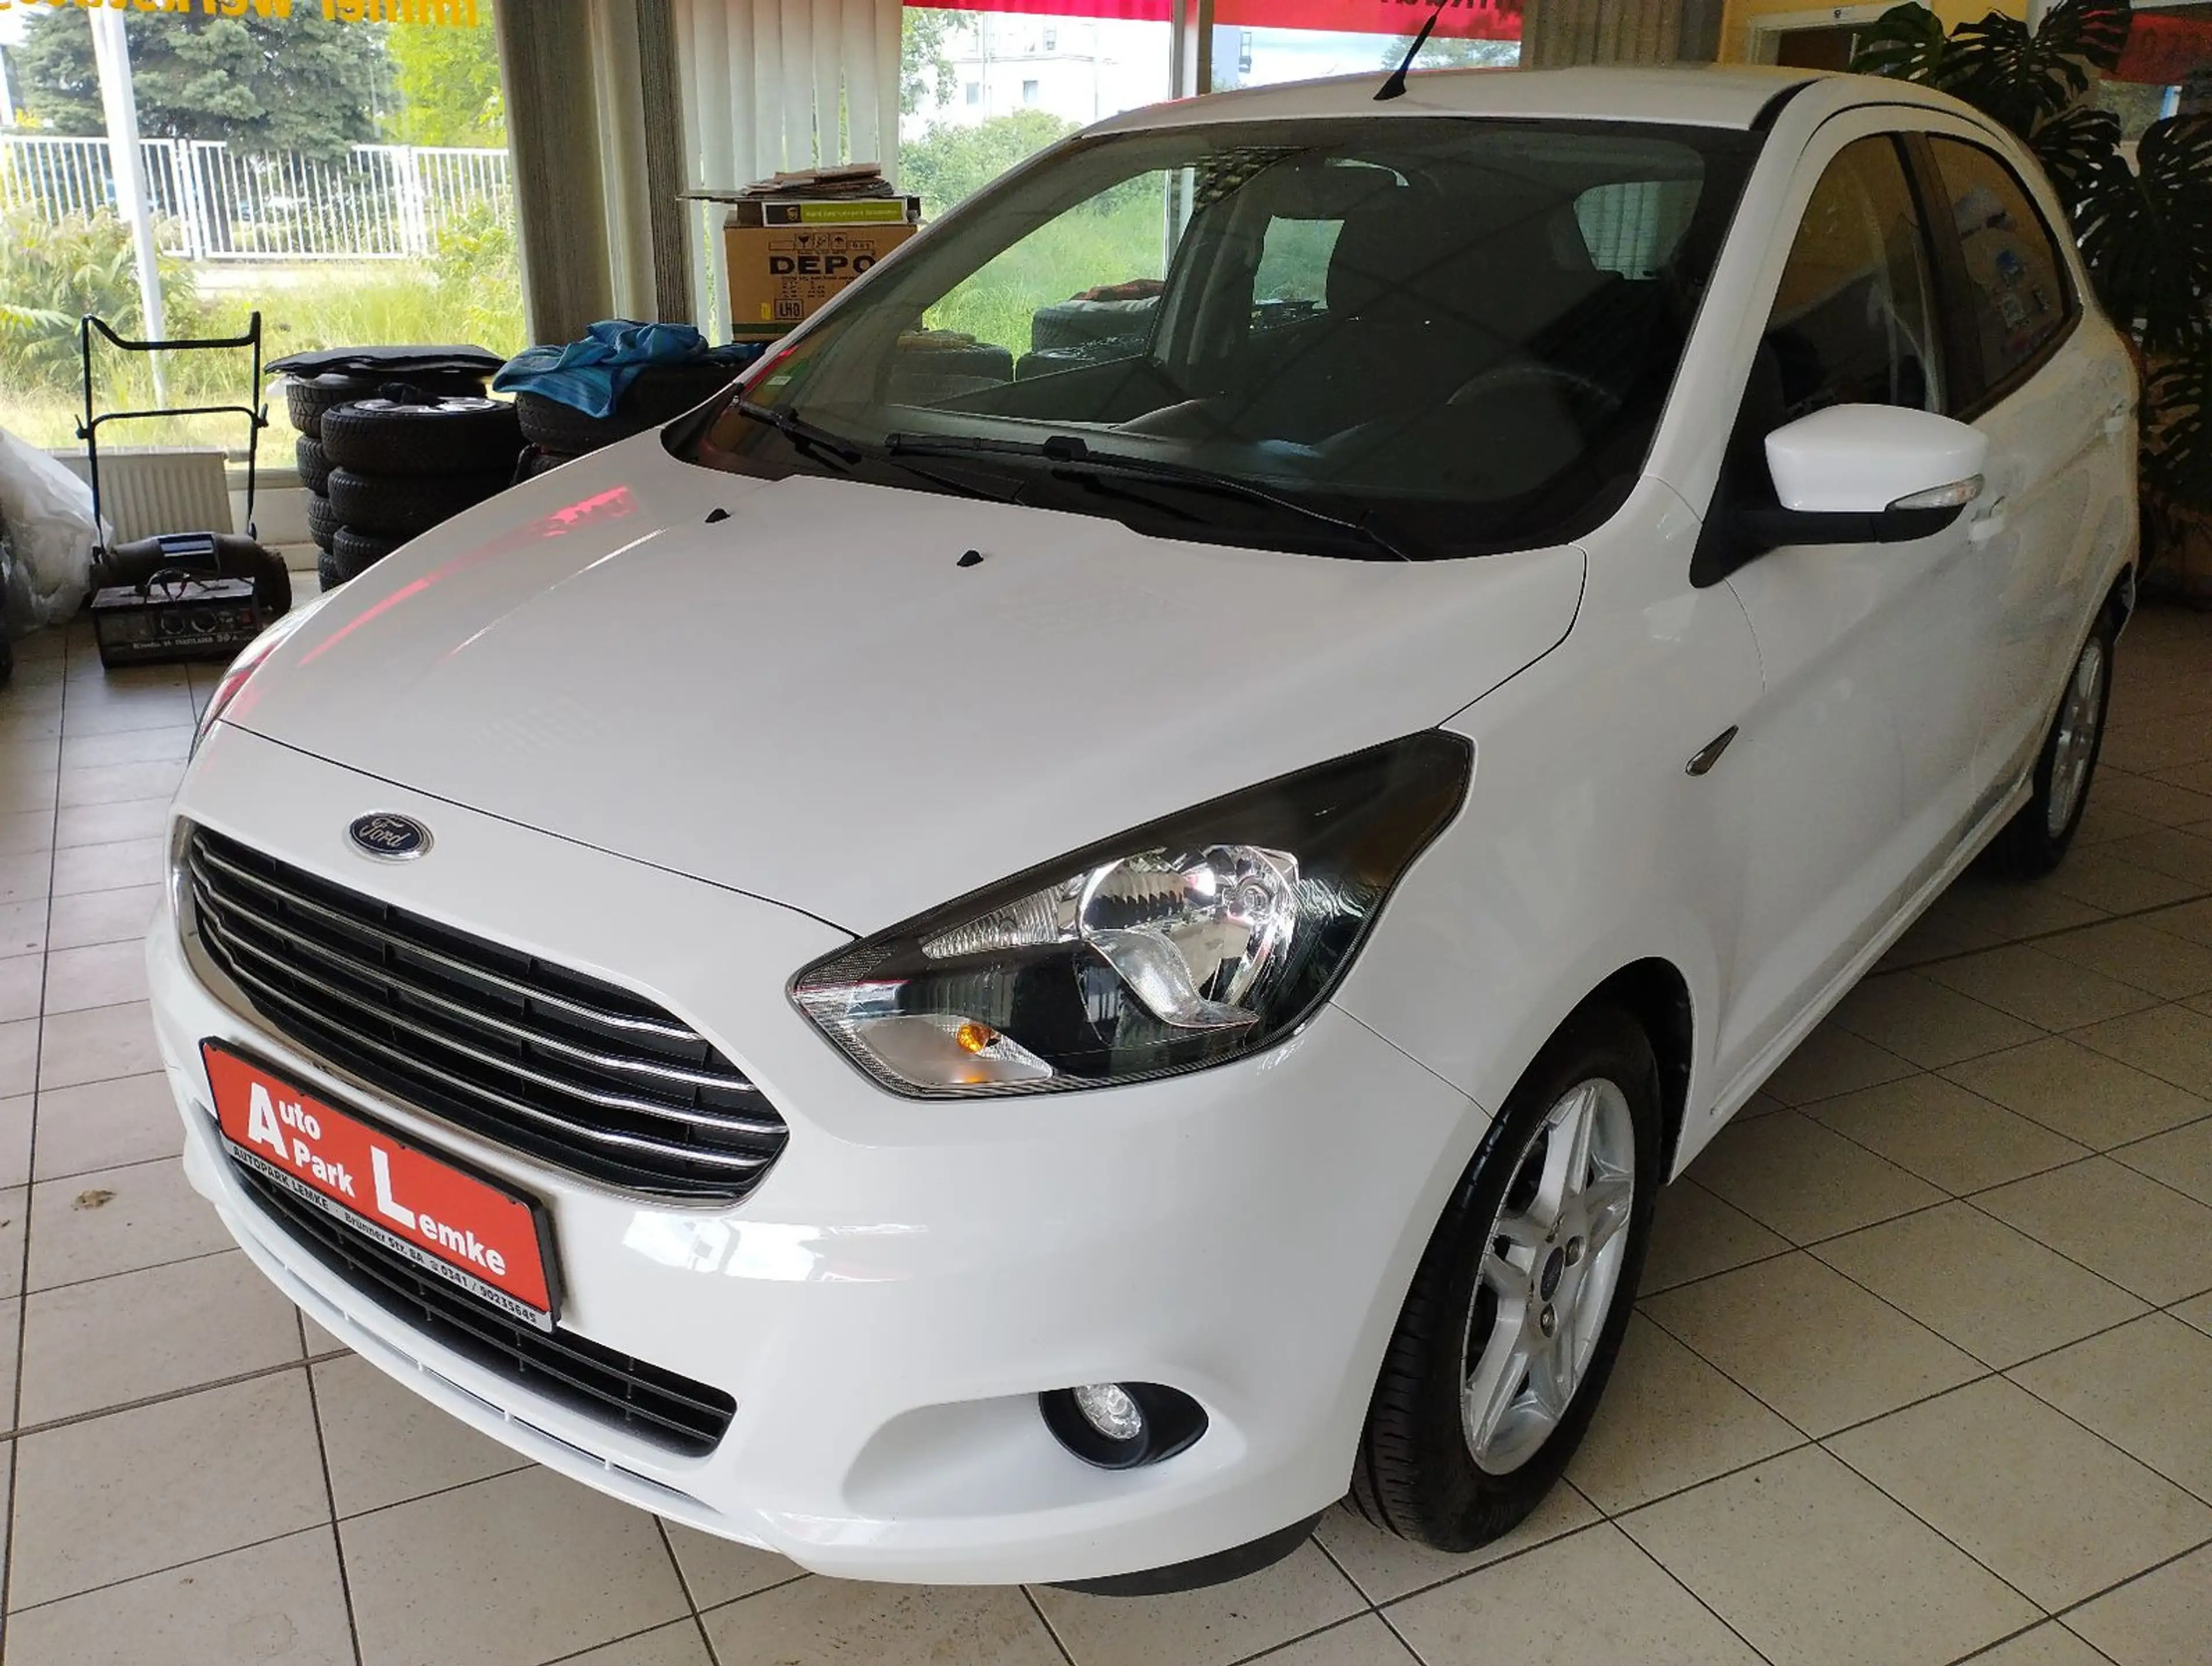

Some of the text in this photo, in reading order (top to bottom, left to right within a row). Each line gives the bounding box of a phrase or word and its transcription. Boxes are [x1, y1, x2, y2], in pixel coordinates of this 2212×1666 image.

[769, 255, 876, 275] DEPO
[359, 817, 411, 847] Ford
[248, 1082, 321, 1160] Auto
[292, 1137, 355, 1199] Park
[233, 1146, 290, 1187] AUTOPARK
[292, 1181, 330, 1211] LEMKE
[388, 1237, 407, 1254] Str.
[440, 1265, 468, 1287] 0341
[370, 1145, 506, 1276] Lemke
